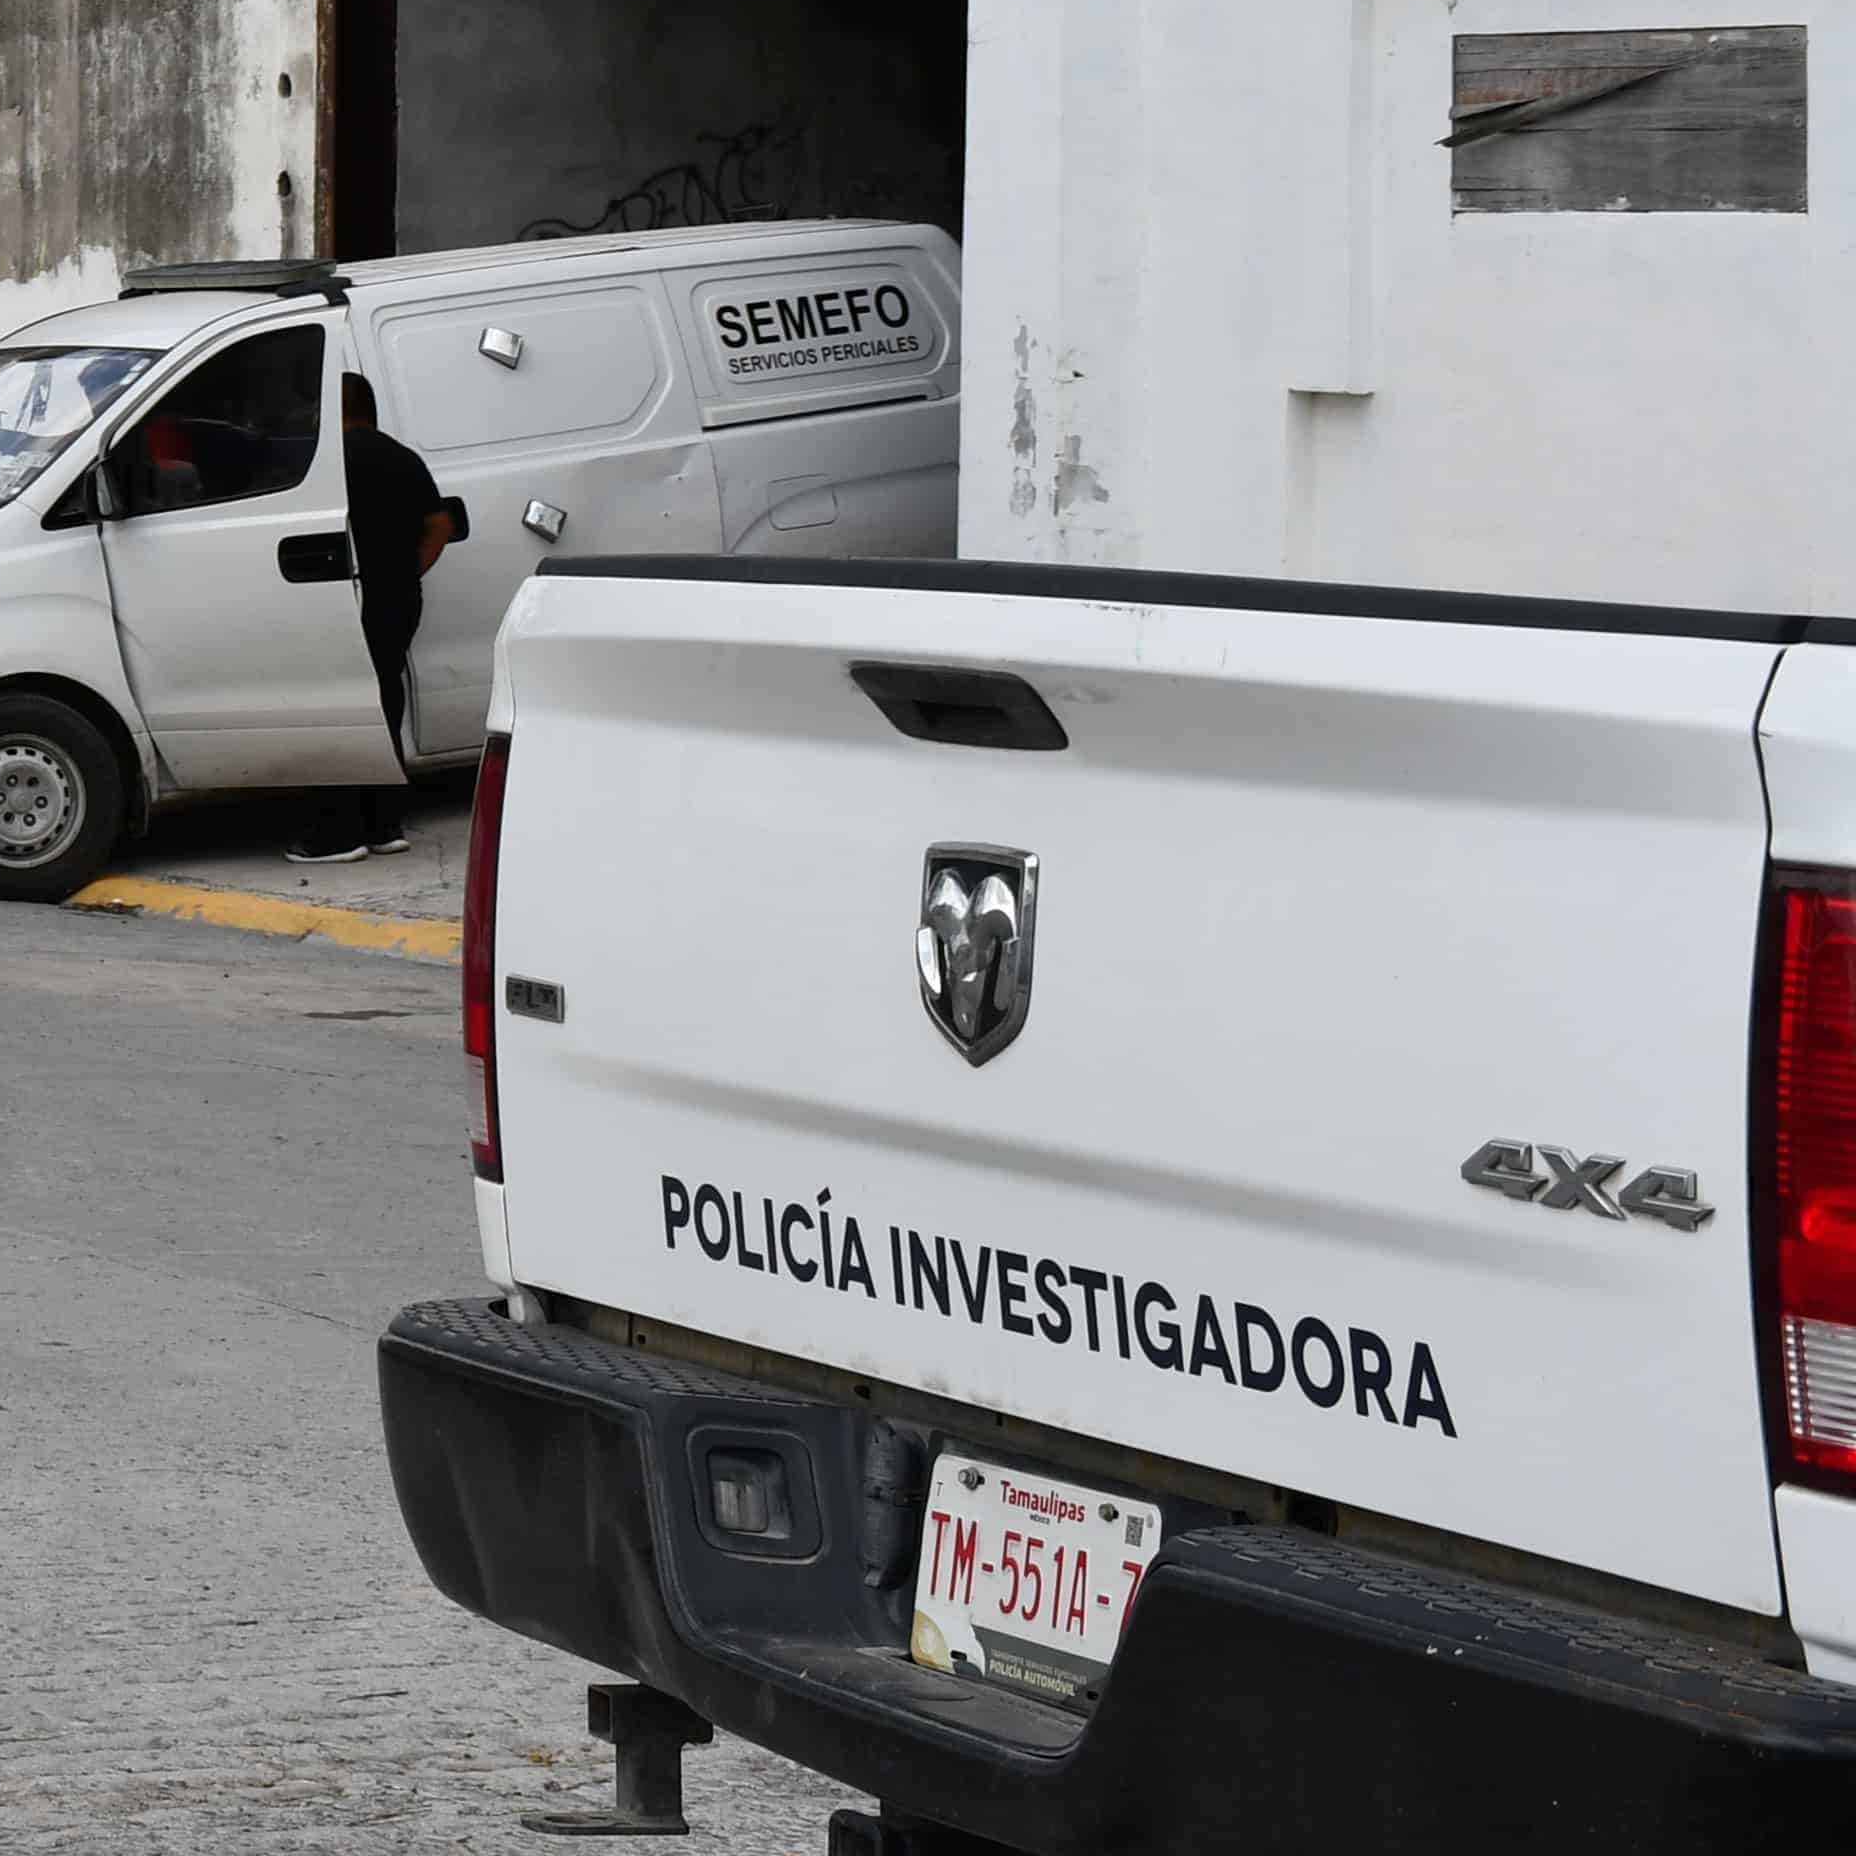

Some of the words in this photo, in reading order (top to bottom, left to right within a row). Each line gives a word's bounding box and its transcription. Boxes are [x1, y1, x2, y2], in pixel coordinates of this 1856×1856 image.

[715, 284, 910, 350] SEMEFO
[728, 347, 819, 375] SERVICIOS
[820, 335, 920, 364] PERICIALES
[661, 1175, 878, 1299] POLICÍA
[888, 1225, 1459, 1440] INVESTIGADORA
[1000, 1480, 1087, 1524] Tamaulipas
[930, 1510, 1143, 1637] TM-551A-7
[989, 1658, 1022, 1682] POLICÍA
[1023, 1670, 1077, 1697] AUTOMÓVIL
